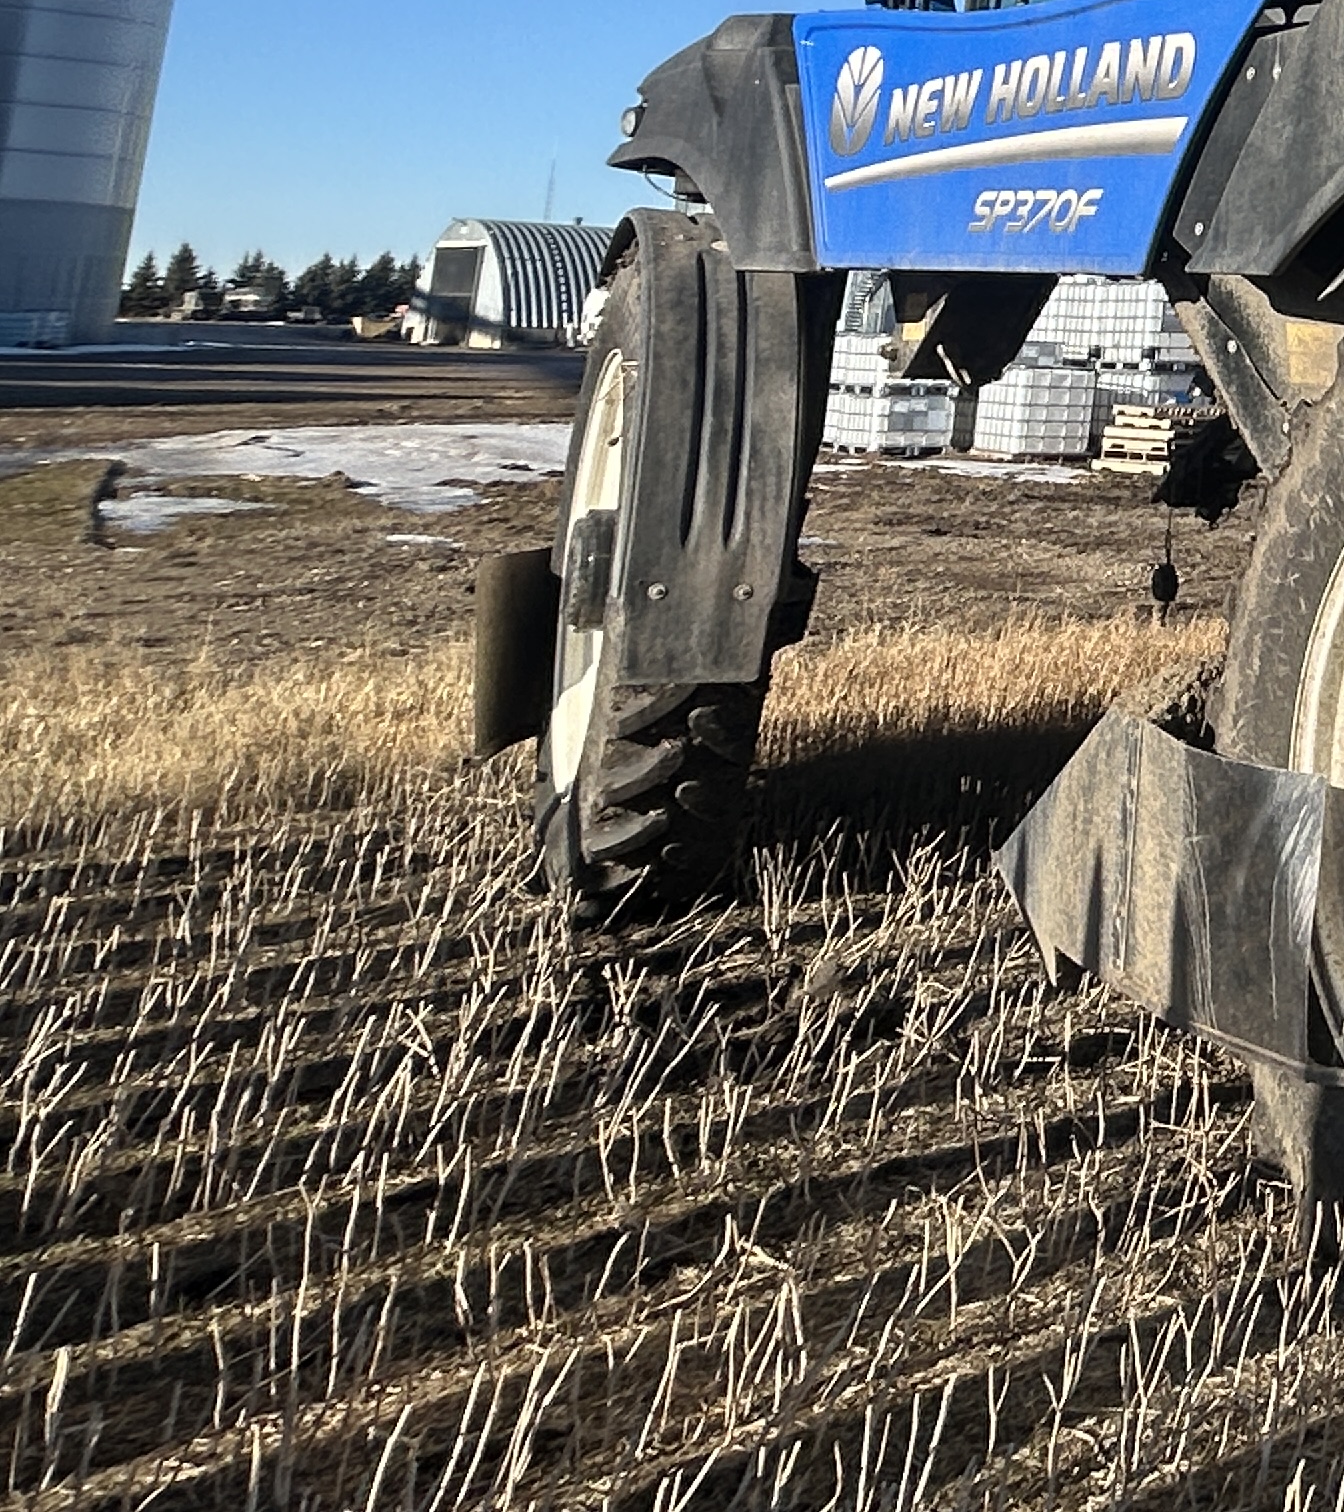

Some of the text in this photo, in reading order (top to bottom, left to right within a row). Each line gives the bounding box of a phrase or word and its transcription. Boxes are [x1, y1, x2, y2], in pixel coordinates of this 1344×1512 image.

[883, 31, 1196, 147] NEW HOLLAND
[967, 188, 1104, 235] SP370F
